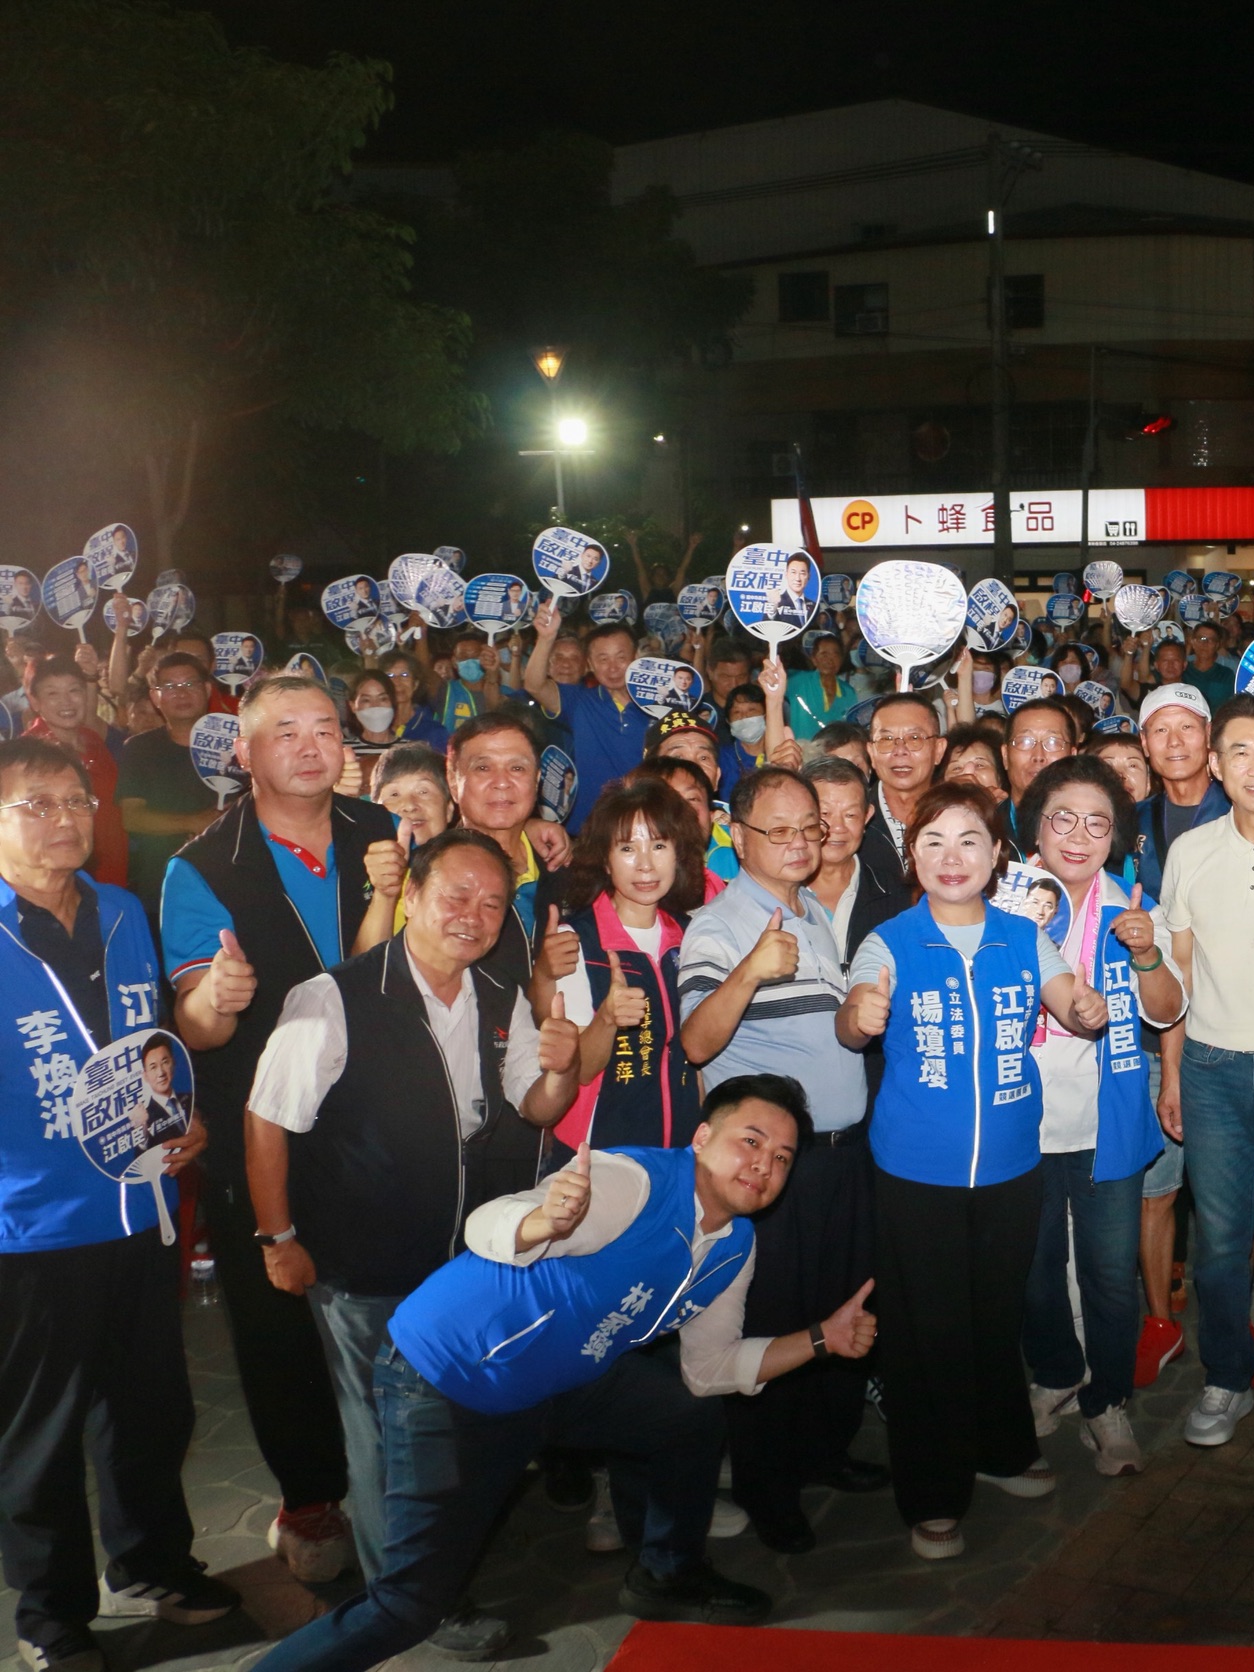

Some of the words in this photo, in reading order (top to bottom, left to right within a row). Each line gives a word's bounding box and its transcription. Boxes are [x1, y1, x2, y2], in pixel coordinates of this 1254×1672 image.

[846, 511, 874, 531] CP
[551, 528, 589, 547] 臺中
[537, 538, 579, 561] 啟程
[742, 547, 789, 566] 臺中
[731, 570, 783, 590] 啟程
[740, 601, 774, 614] 江啟臣
[638, 660, 677, 673] 臺中
[1013, 668, 1043, 681] 臺中
[629, 671, 671, 686] 啟程
[1004, 681, 1039, 696] 啟程
[193, 732, 235, 751] 啟程
[1104, 960, 1137, 1055] 江啟臣
[949, 991, 965, 1056] 立法委員
[910, 990, 949, 1090] 楊瓊瓔
[992, 985, 1025, 1085] 江啟臣
[85, 1044, 144, 1094] 臺中
[82, 1080, 146, 1136] 啟程
[102, 1133, 147, 1164] 江啟臣
